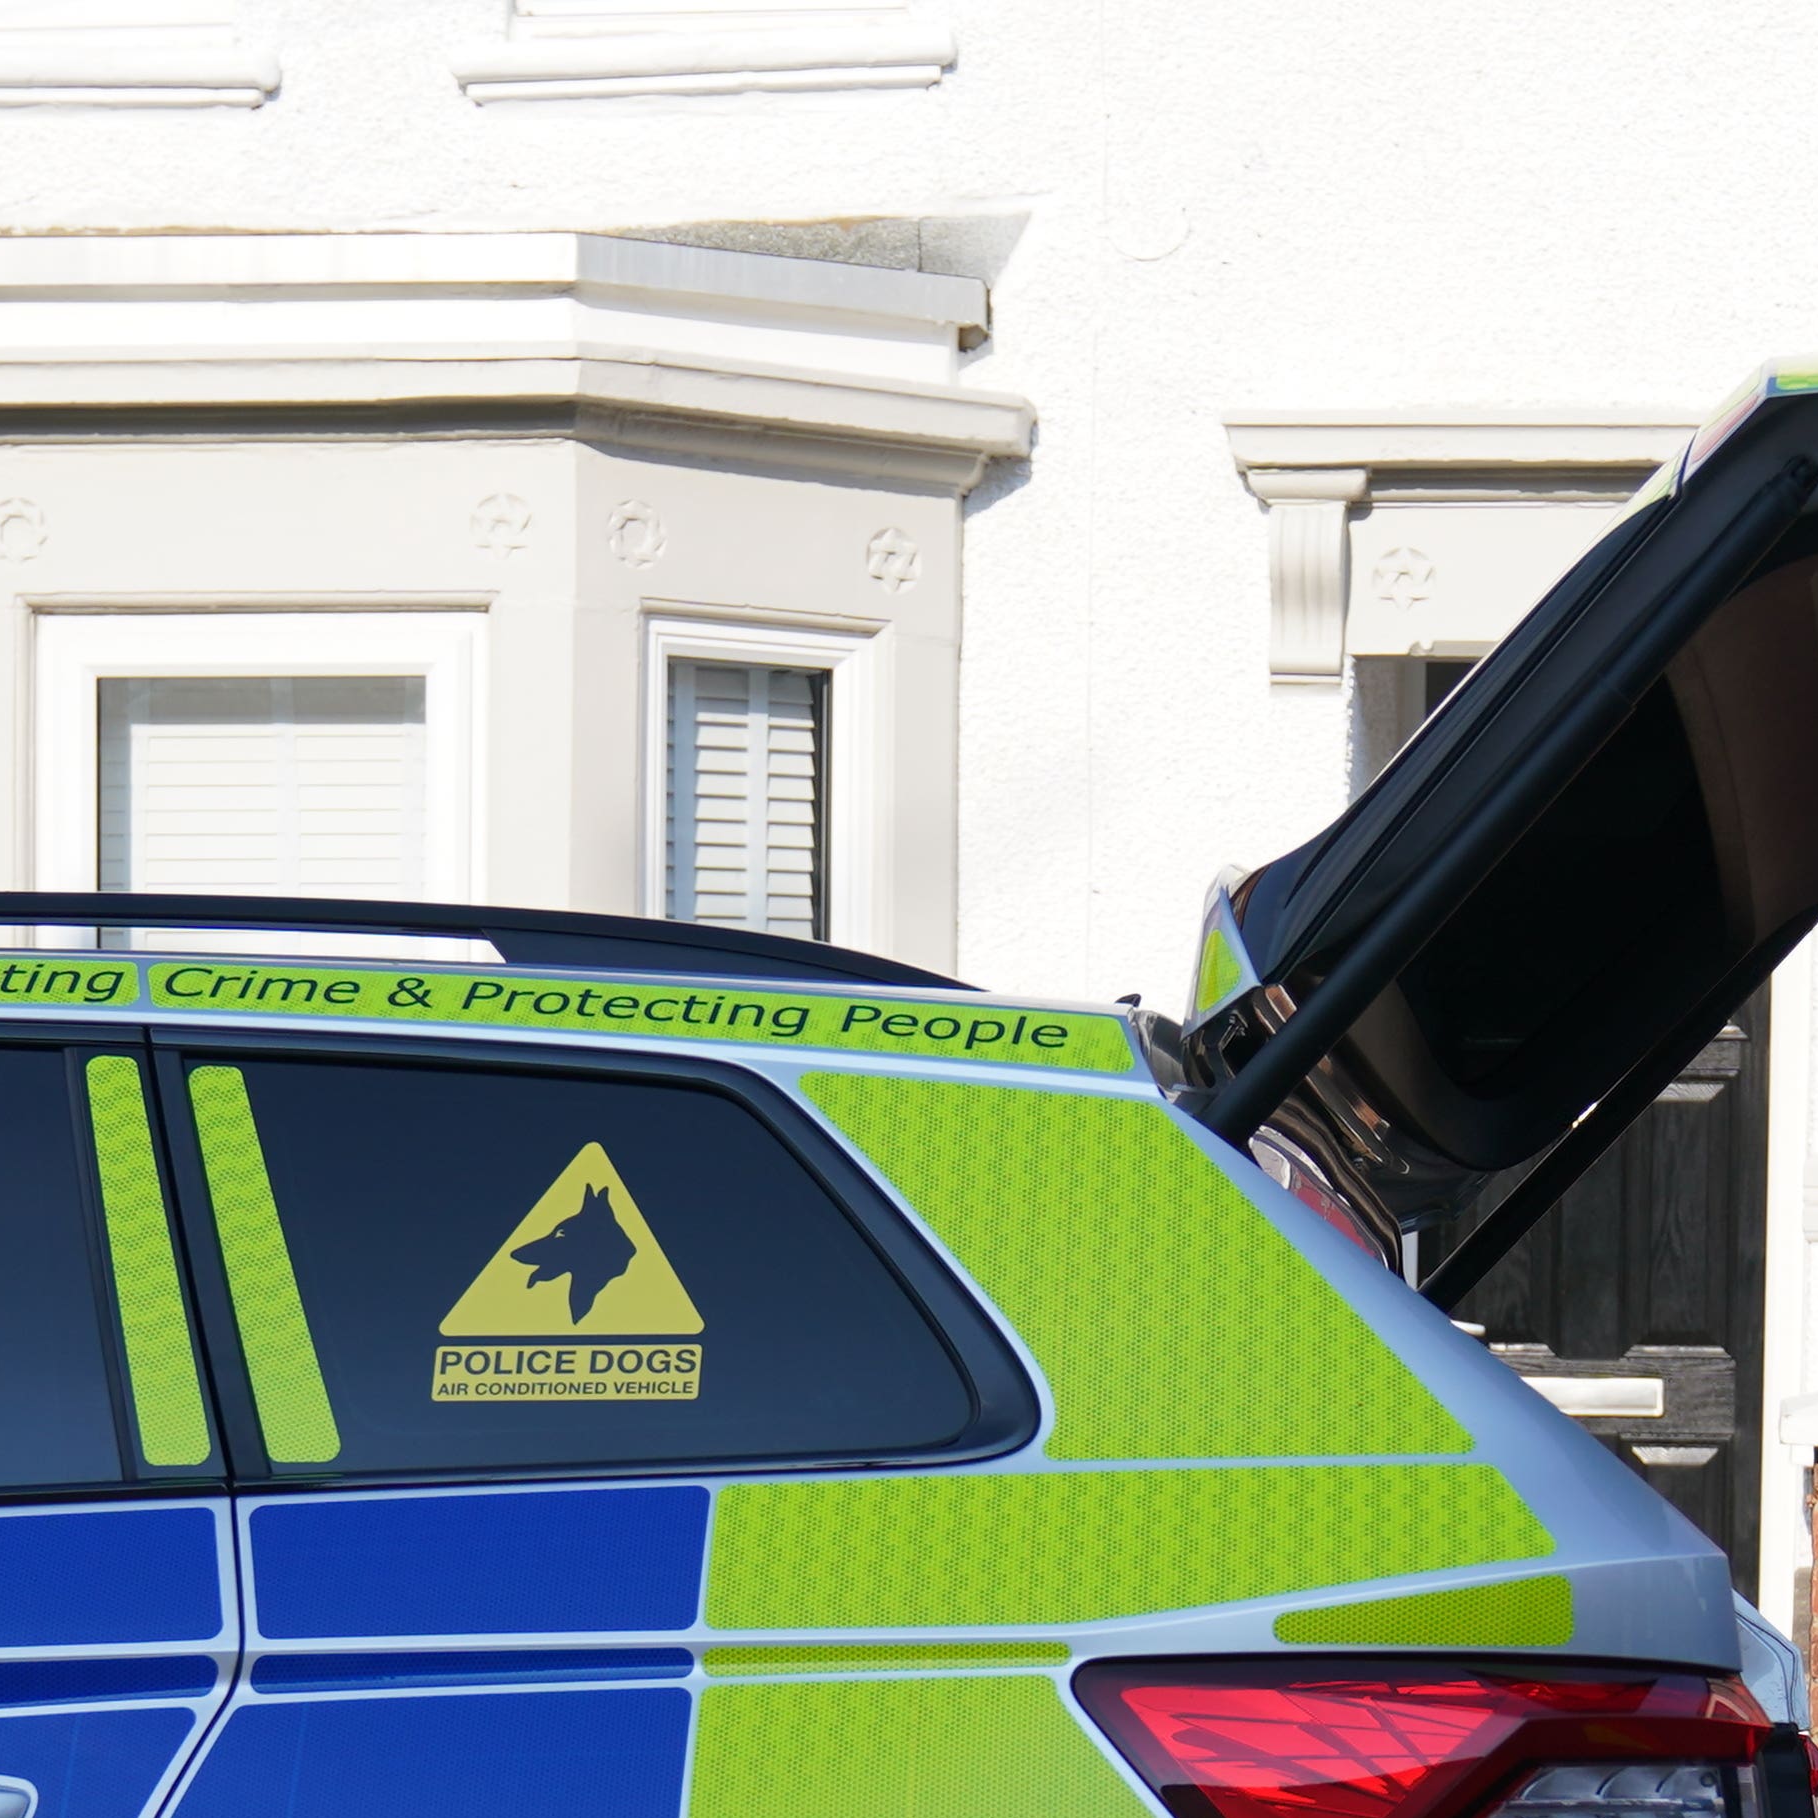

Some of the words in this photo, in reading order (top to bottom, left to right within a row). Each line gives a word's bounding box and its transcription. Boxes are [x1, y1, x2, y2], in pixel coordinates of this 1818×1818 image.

[164, 966, 358, 1005] Crime
[387, 977, 433, 1009] &
[462, 981, 810, 1037] Protecting
[842, 1005, 1069, 1050] People
[439, 1350, 577, 1375] POLICE
[589, 1348, 697, 1374] DOGS
[437, 1383, 469, 1396] AIR
[475, 1381, 607, 1396] CONDITIONED
[613, 1380, 694, 1395] VEHICLE
